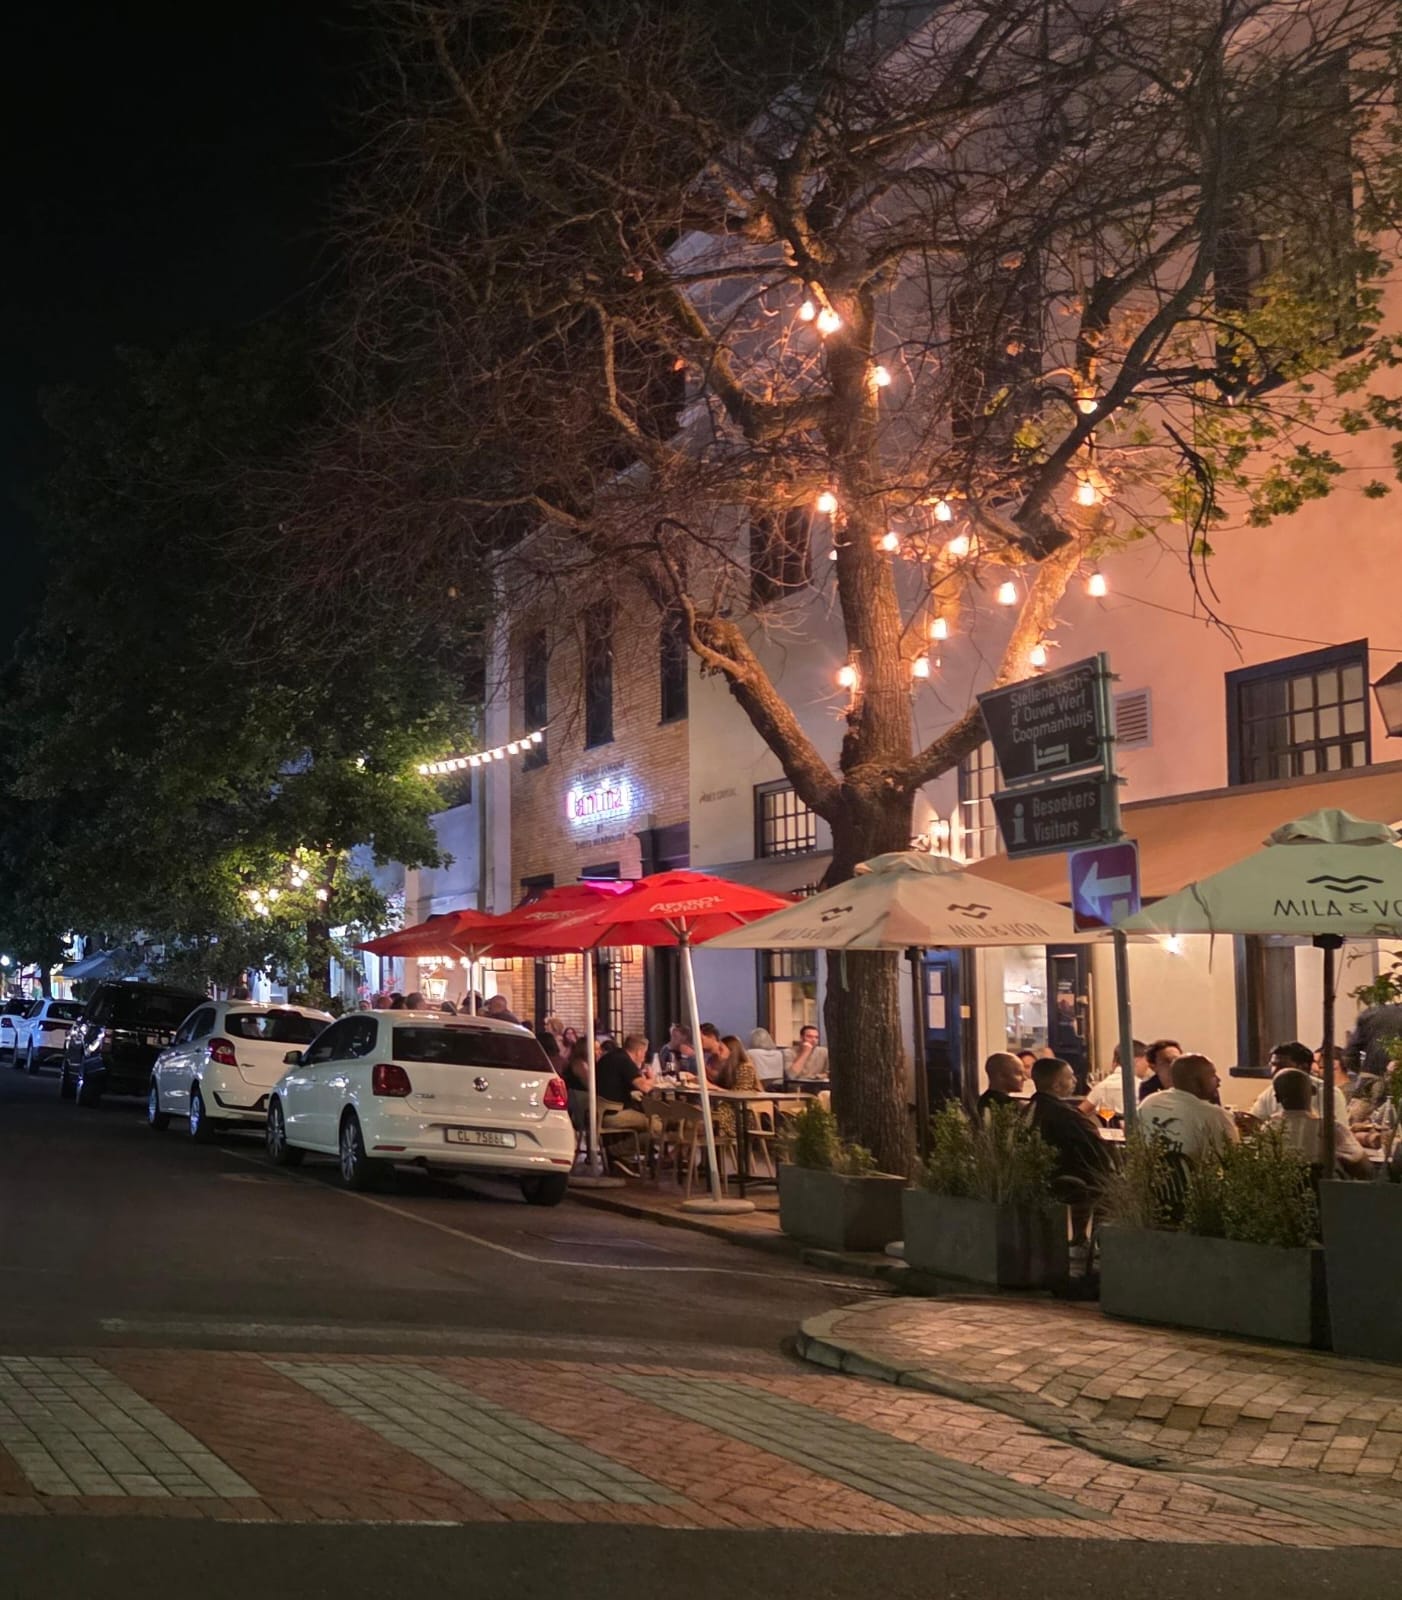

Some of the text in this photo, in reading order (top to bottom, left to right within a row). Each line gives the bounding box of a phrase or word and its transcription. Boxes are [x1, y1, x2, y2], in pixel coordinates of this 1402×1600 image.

[1023, 702, 1056, 722] Ouwe
[1057, 688, 1086, 713] Werf
[1032, 791, 1096, 818] Besoekers
[1033, 820, 1079, 843] Visitors
[1273, 899, 1343, 917] MILA
[1349, 902, 1369, 914] &
[1001, 922, 1051, 938] VON
